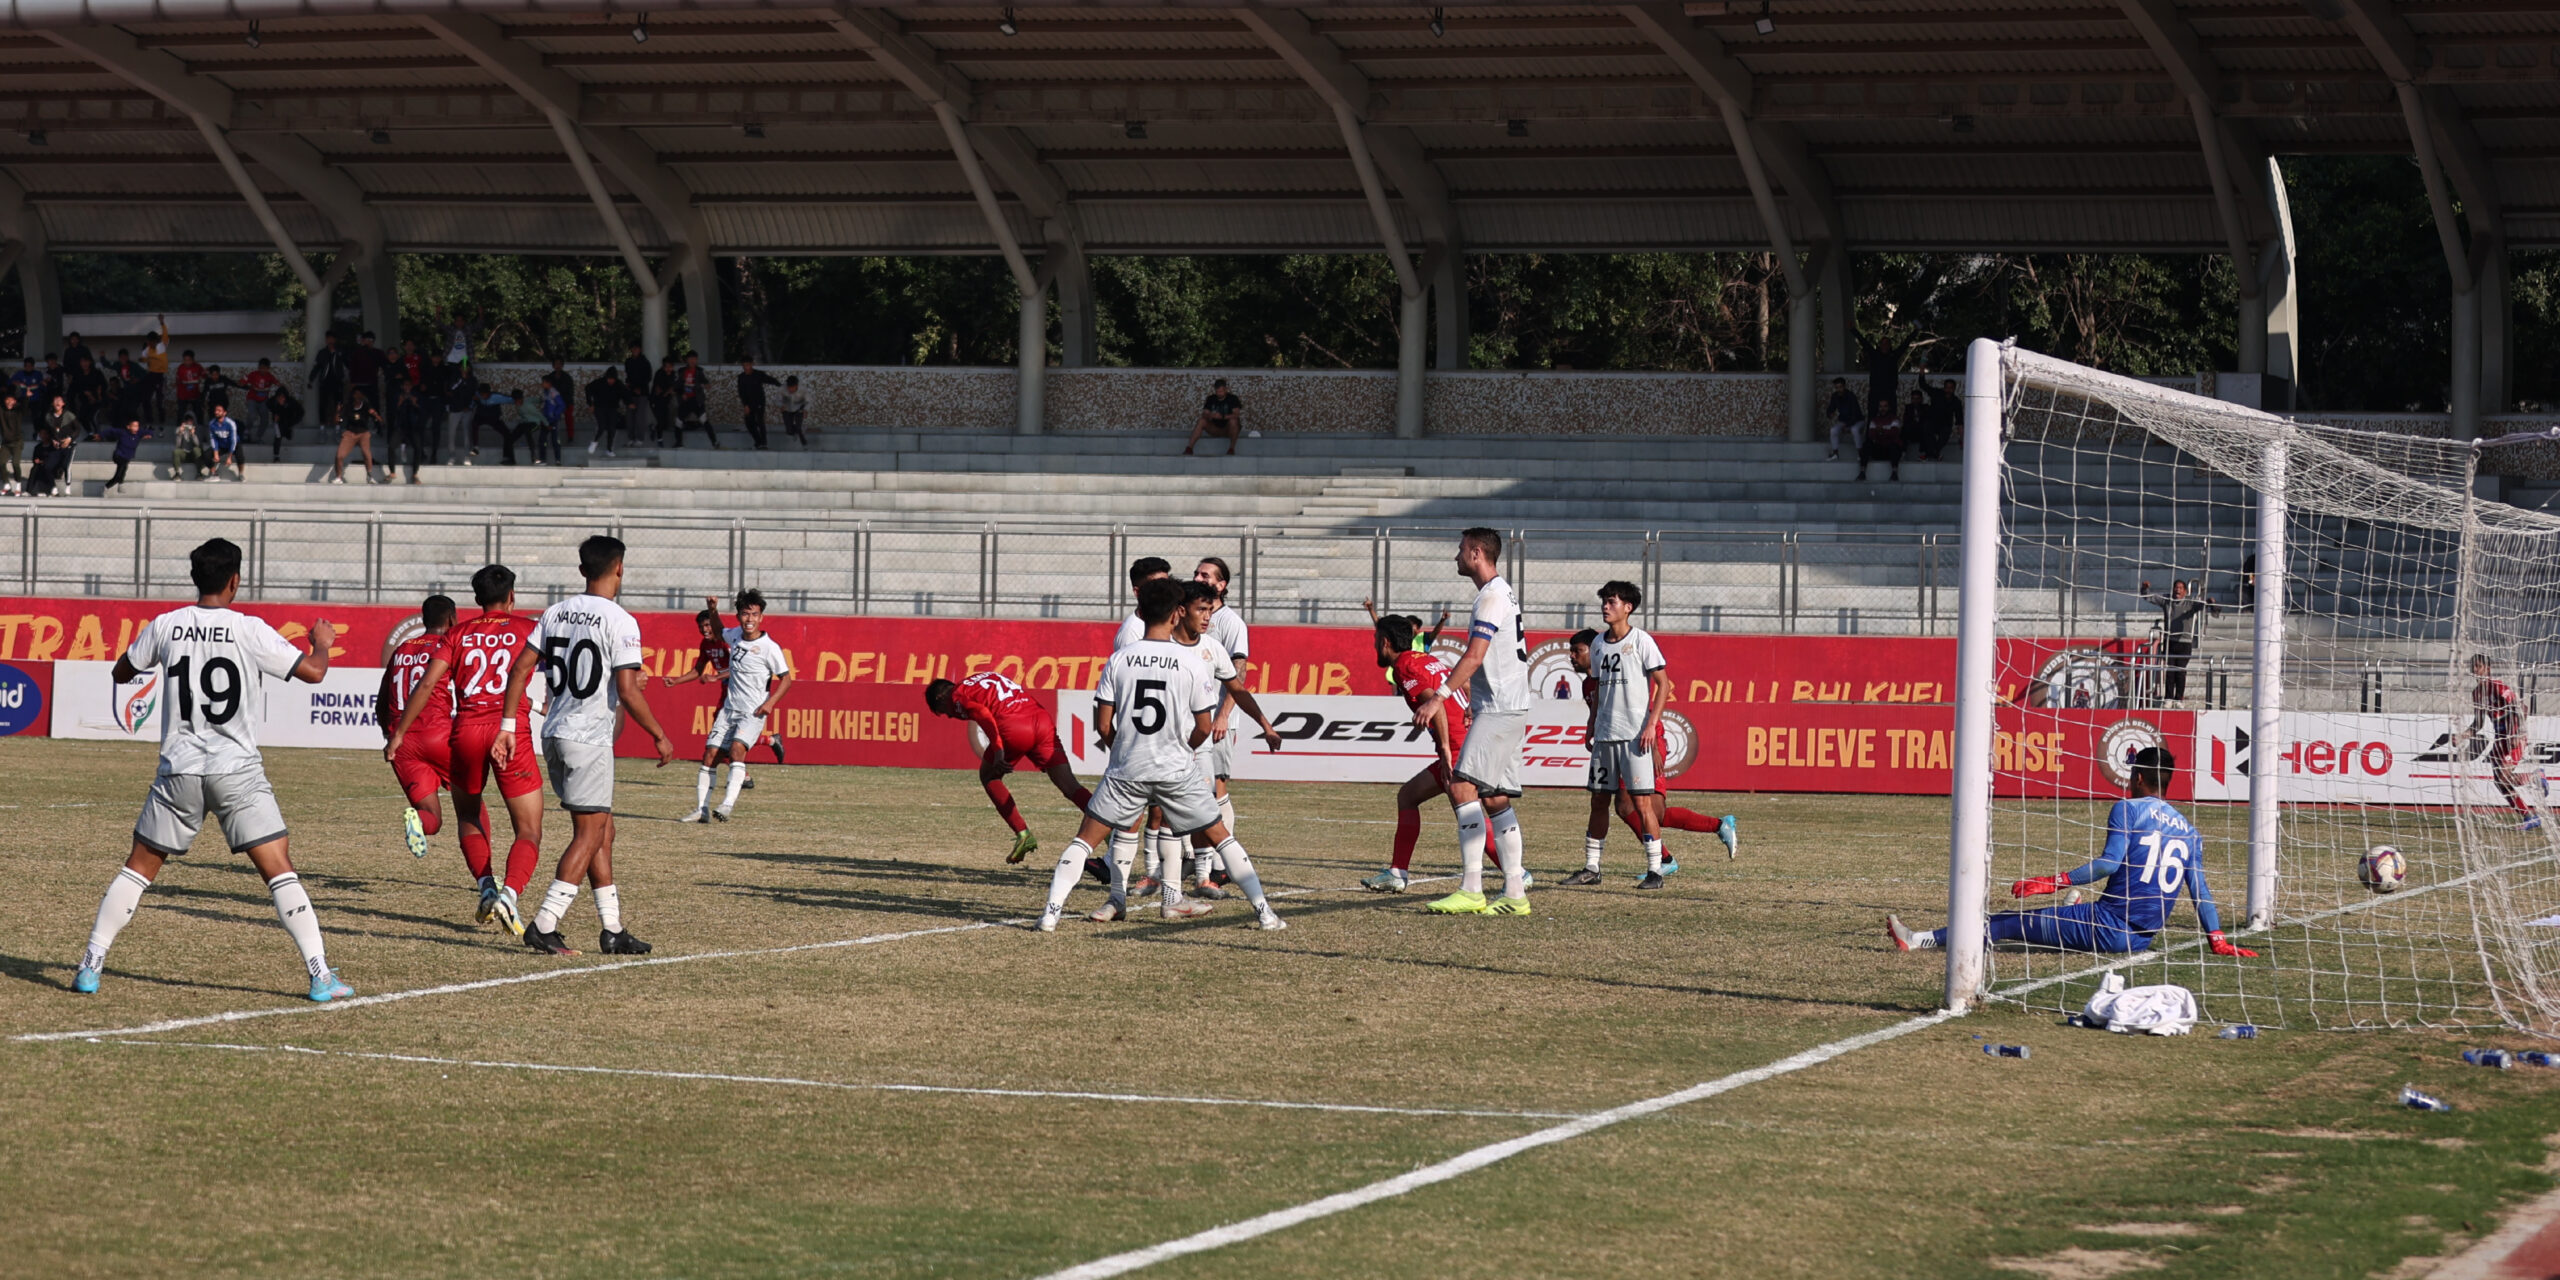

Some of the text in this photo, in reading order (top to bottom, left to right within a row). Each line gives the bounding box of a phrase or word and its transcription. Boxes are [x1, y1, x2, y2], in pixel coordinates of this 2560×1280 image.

[554, 610, 602, 628] NAOCHA
[0, 614, 154, 661] TRAI
[172, 626, 234, 642] DANIEL
[462, 632, 516, 647] ETO'O
[731, 645, 748, 663] 27
[1126, 655, 1179, 671] VALPUIA
[1600, 653, 1621, 673] 42
[465, 648, 511, 697] 23
[546, 637, 603, 699] 50
[168, 656, 240, 725] 19
[311, 692, 364, 707] INDIAN
[1131, 679, 1167, 735] 5
[787, 708, 823, 739] BHI
[829, 710, 919, 743] KHELEGI
[1746, 726, 1876, 768] BELIEVE
[1589, 766, 1609, 785] 42
[2150, 807, 2189, 833] KIRAN
[2138, 830, 2189, 894] 16
